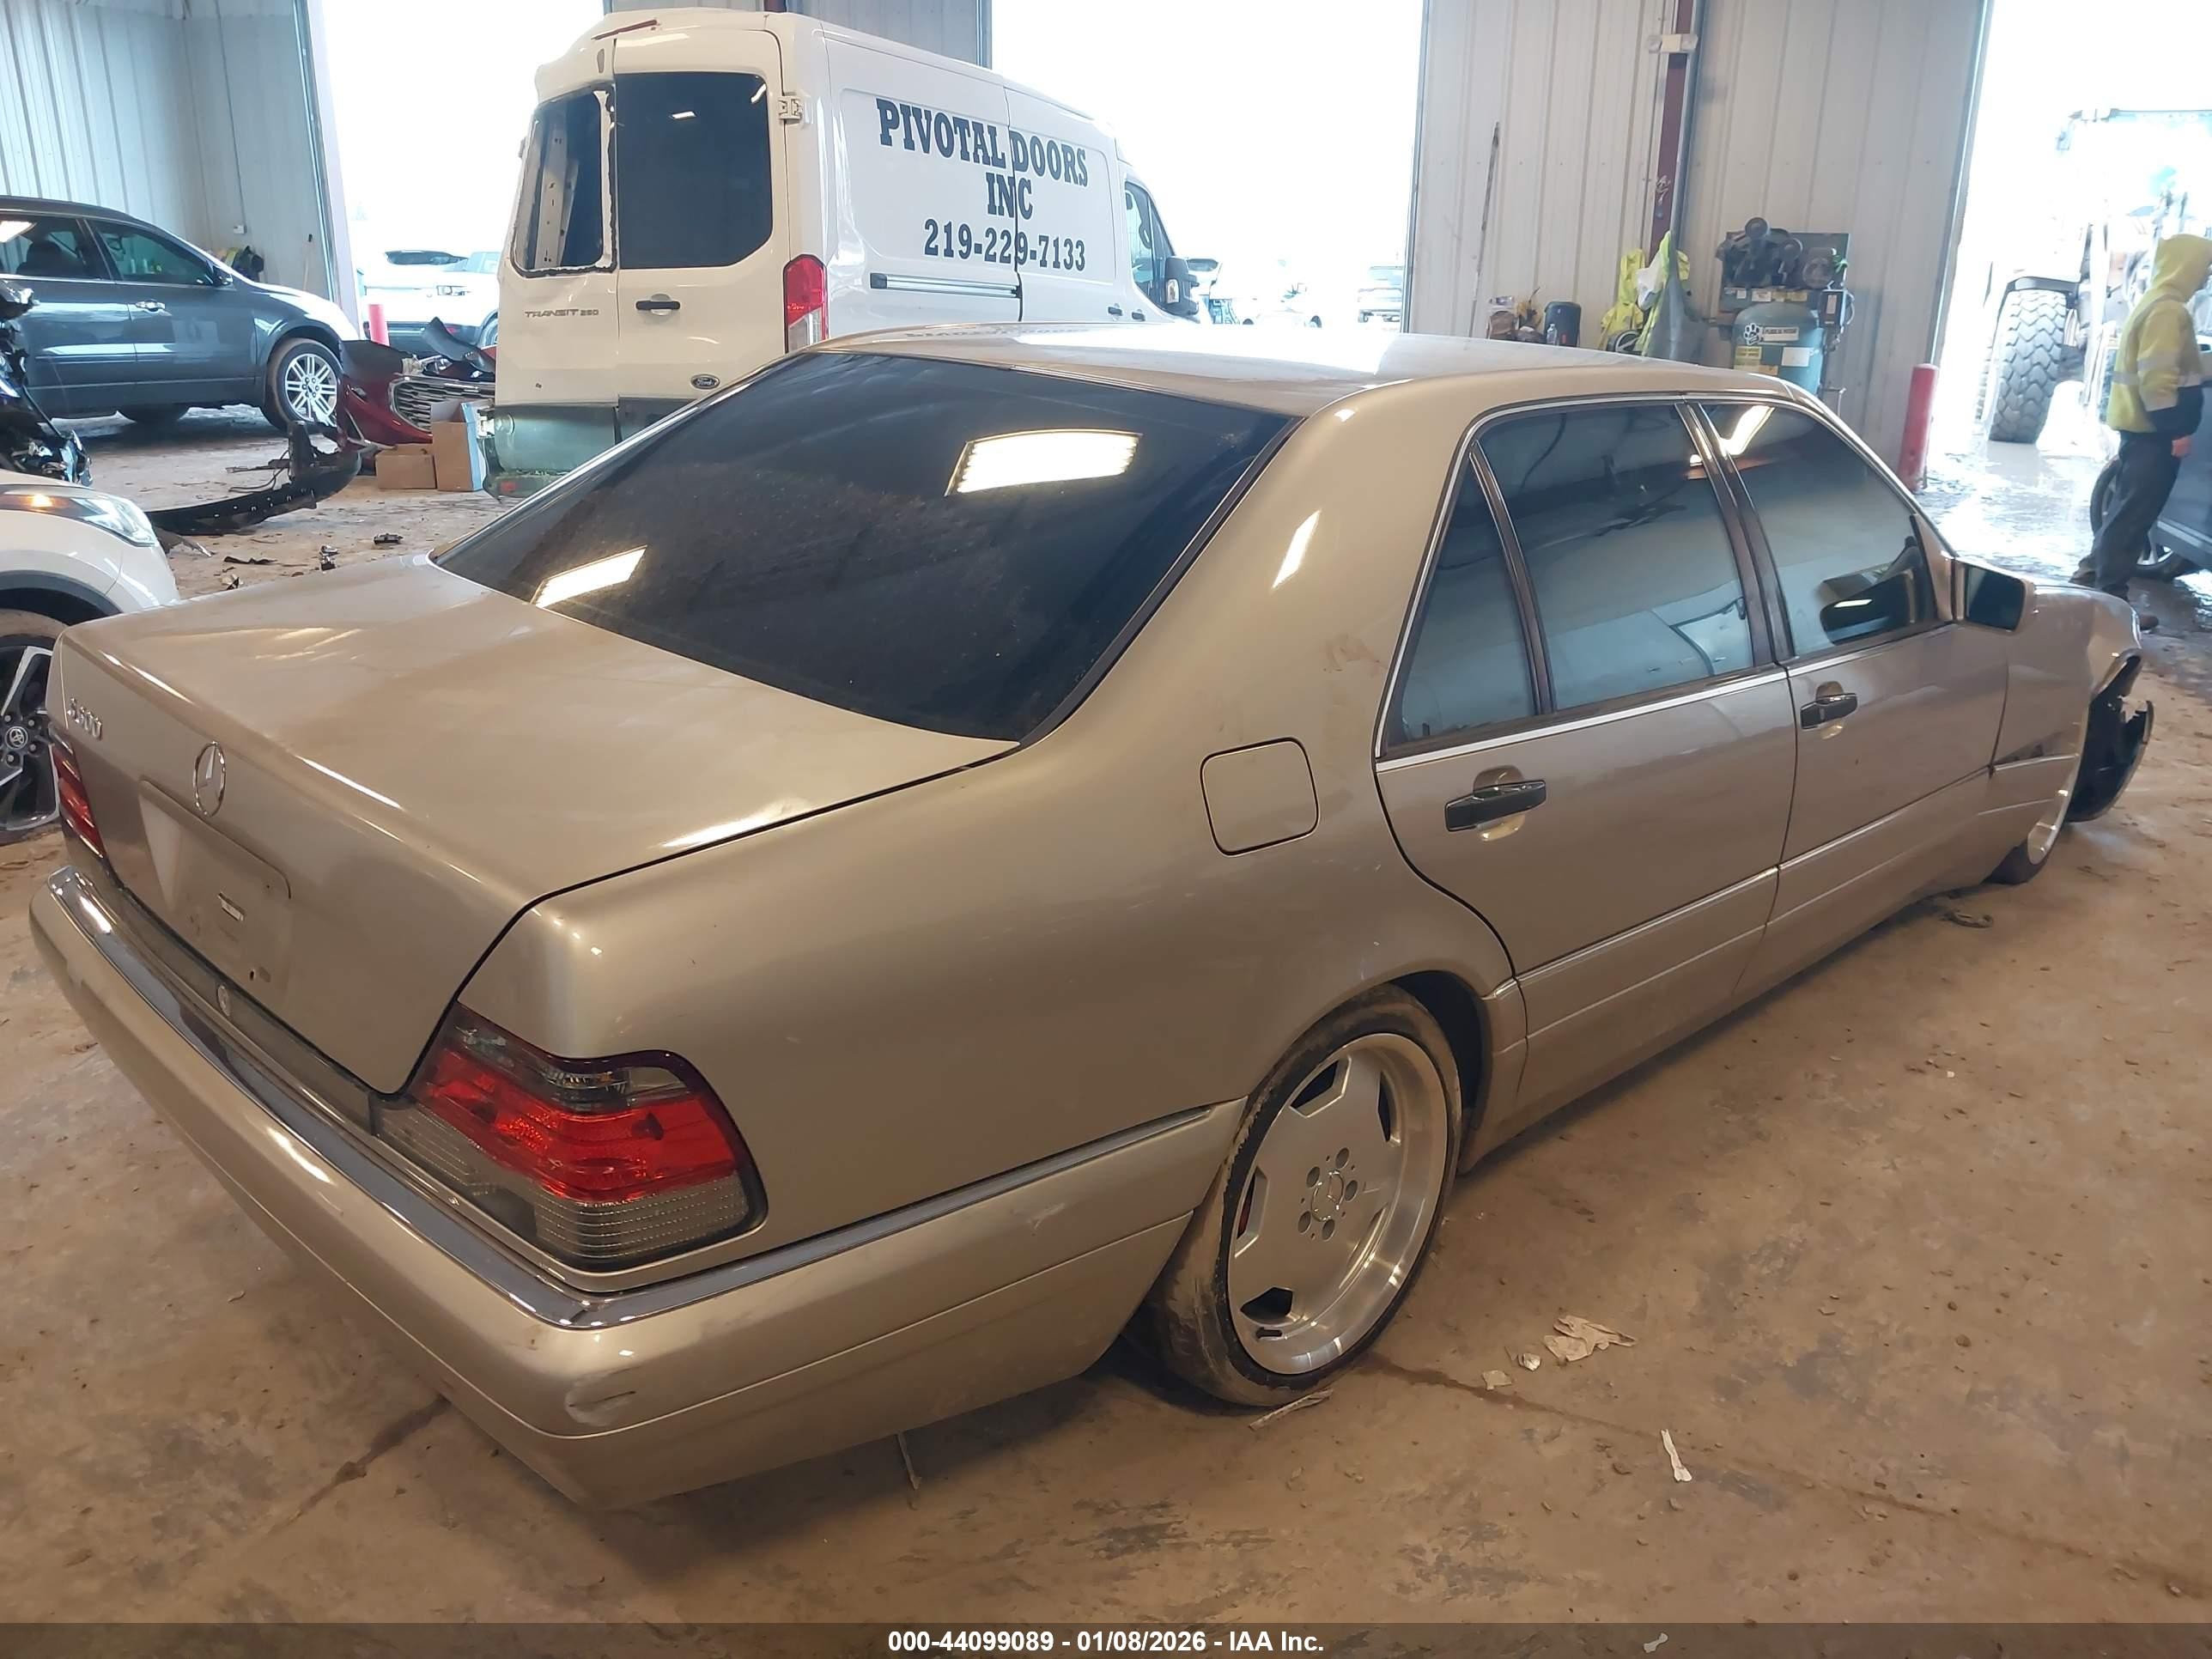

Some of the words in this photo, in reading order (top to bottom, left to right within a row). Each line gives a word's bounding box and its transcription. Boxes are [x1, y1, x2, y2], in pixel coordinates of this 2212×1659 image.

[876, 98, 1006, 169] PIVOTAL
[1009, 130, 1088, 187] DOORS
[986, 173, 1033, 220] INC
[924, 219, 1085, 271] 219-229-7133
[524, 308, 579, 318] TRANSIT
